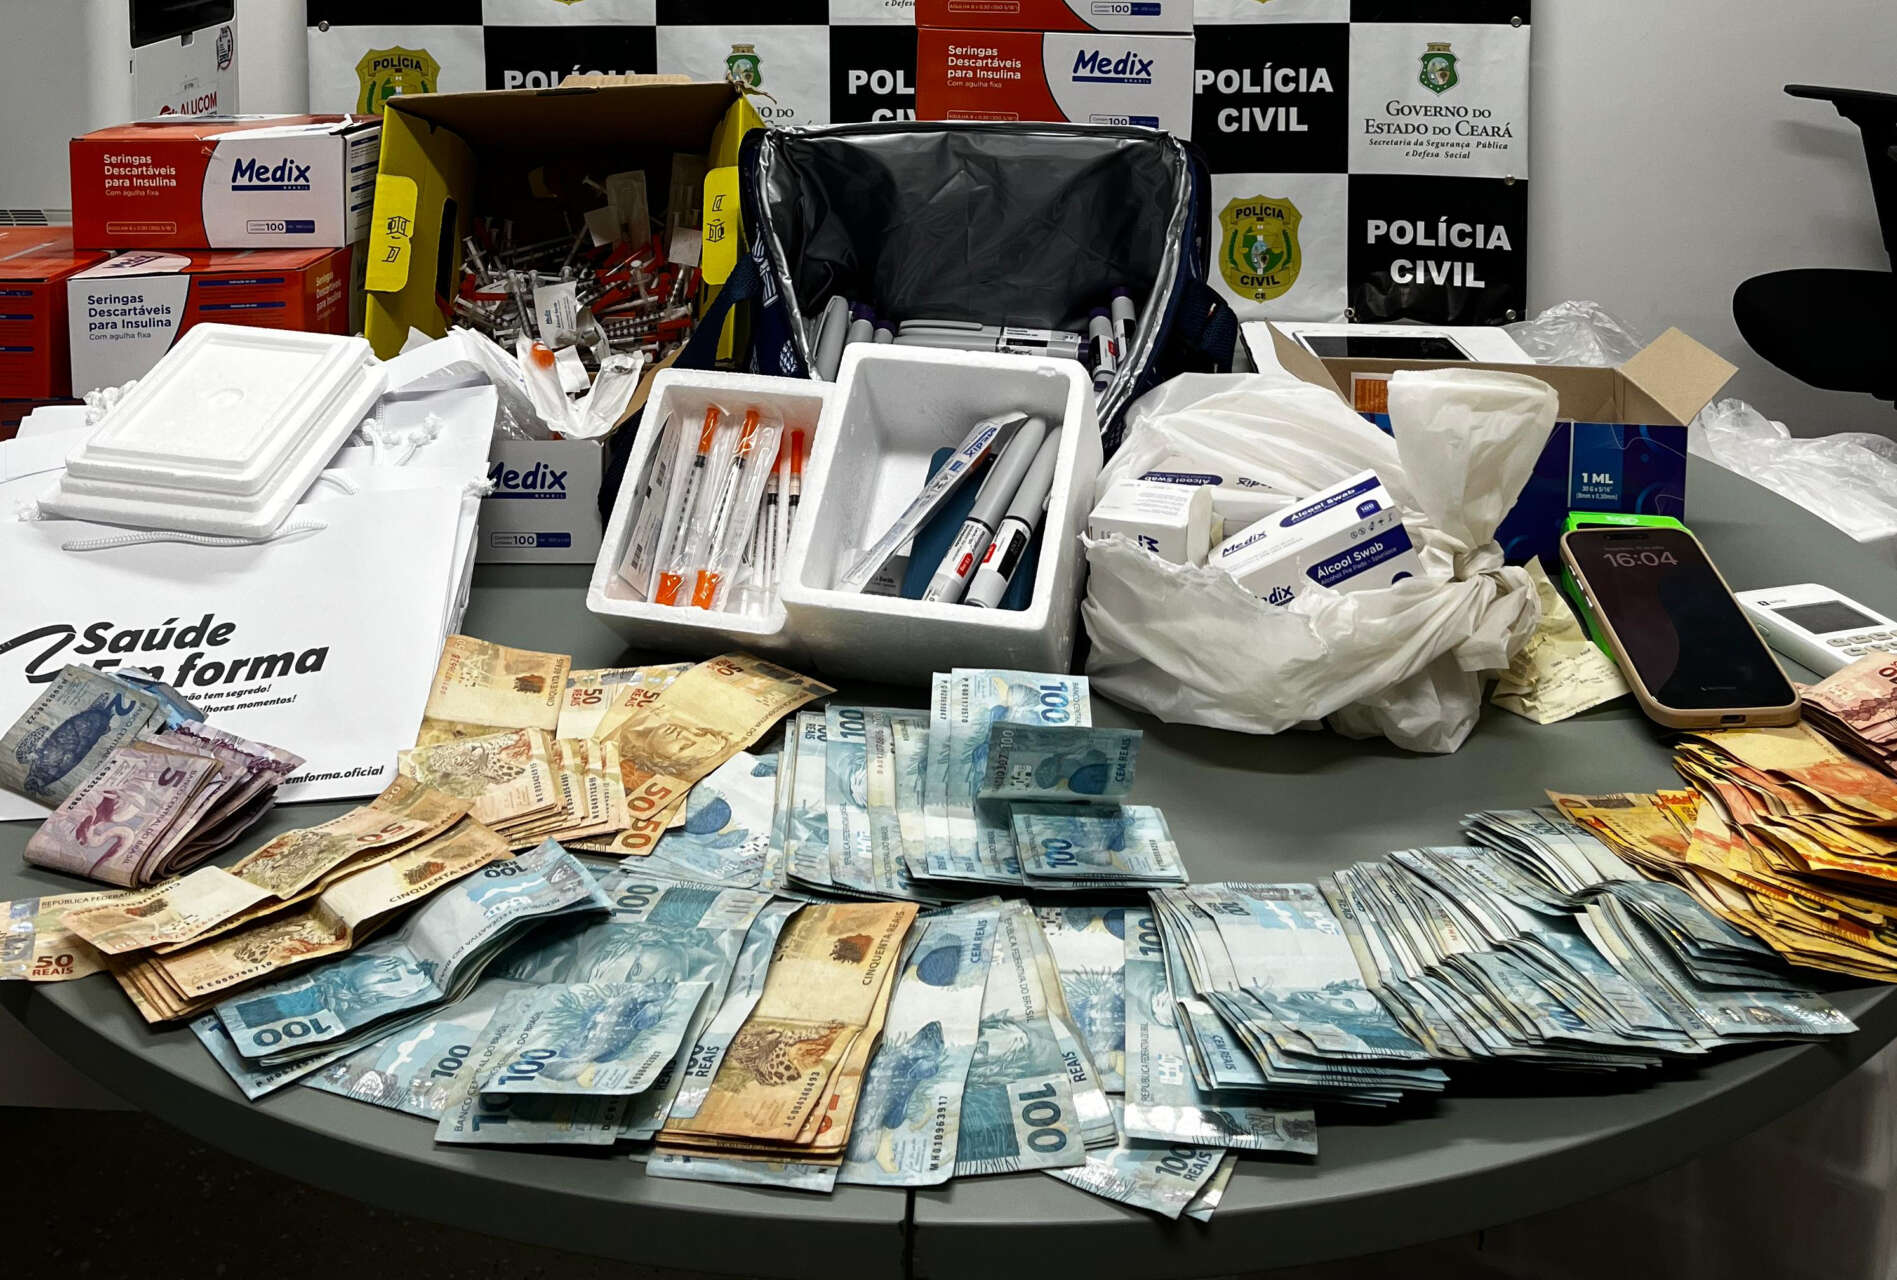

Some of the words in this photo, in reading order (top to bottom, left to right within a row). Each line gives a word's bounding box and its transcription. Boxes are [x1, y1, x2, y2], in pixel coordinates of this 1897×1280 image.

[1194, 61, 1334, 94] POLÍCIA
[1217, 107, 1308, 133] CIVIL
[104, 154, 152, 165] Seringas
[104, 166, 176, 175] Descartáveis
[232, 158, 311, 183] Medix
[105, 178, 130, 188] para
[133, 177, 177, 187] Insulina
[266, 222, 284, 231] 100
[1367, 213, 1512, 251] POLÍCIA
[1390, 259, 1485, 288] CIVIL
[87, 294, 144, 305] Seringas
[88, 304, 171, 317] Descartáveis
[89, 319, 117, 331] para
[122, 317, 172, 328] Insulina
[89, 332, 108, 341] Com
[1582, 473, 1588, 483] 1
[1592, 473, 1614, 484] ML
[1222, 531, 1267, 556] Medix
[1353, 542, 1384, 561] Swab
[1603, 551, 1679, 568] 16:04
[74, 613, 237, 655] Saúde
[173, 646, 330, 688] forma
[105, 692, 136, 717] 2
[203, 691, 224, 700] tem
[225, 684, 272, 699] segredo!
[236, 694, 298, 712] momentos!
[570, 688, 583, 708] REAIS
[583, 689, 603, 706] 50
[1040, 681, 1070, 723] 100
[839, 709, 866, 739] 100
[1000, 729, 1014, 750] 100
[1118, 736, 1132, 762] REAIS
[158, 767, 187, 787] 5
[281, 765, 384, 785] emforma.oficial
[1115, 761, 1129, 783] CEM
[627, 783, 673, 814] 50
[356, 824, 405, 843] 50
[621, 819, 662, 850] 50
[1042, 838, 1078, 869] 100
[389, 866, 459, 903] CINQUENTA
[460, 852, 494, 877] REAIS
[611, 884, 659, 917] 100
[973, 919, 988, 944] REAIS
[1138, 918, 1163, 956] 100
[862, 936, 892, 986] CINQUENTA
[889, 910, 906, 940] REAIS
[970, 943, 982, 964] CEM
[32, 967, 74, 976] REAIS
[36, 954, 75, 968] 50
[252, 1017, 333, 1047] 100
[430, 1045, 471, 1079] 100
[498, 1048, 557, 1086] 100
[695, 1045, 720, 1079] REAIS
[1063, 1051, 1087, 1083] REAIS
[1018, 1083, 1068, 1154] 100
[1182, 1150, 1213, 1182] REAIS
